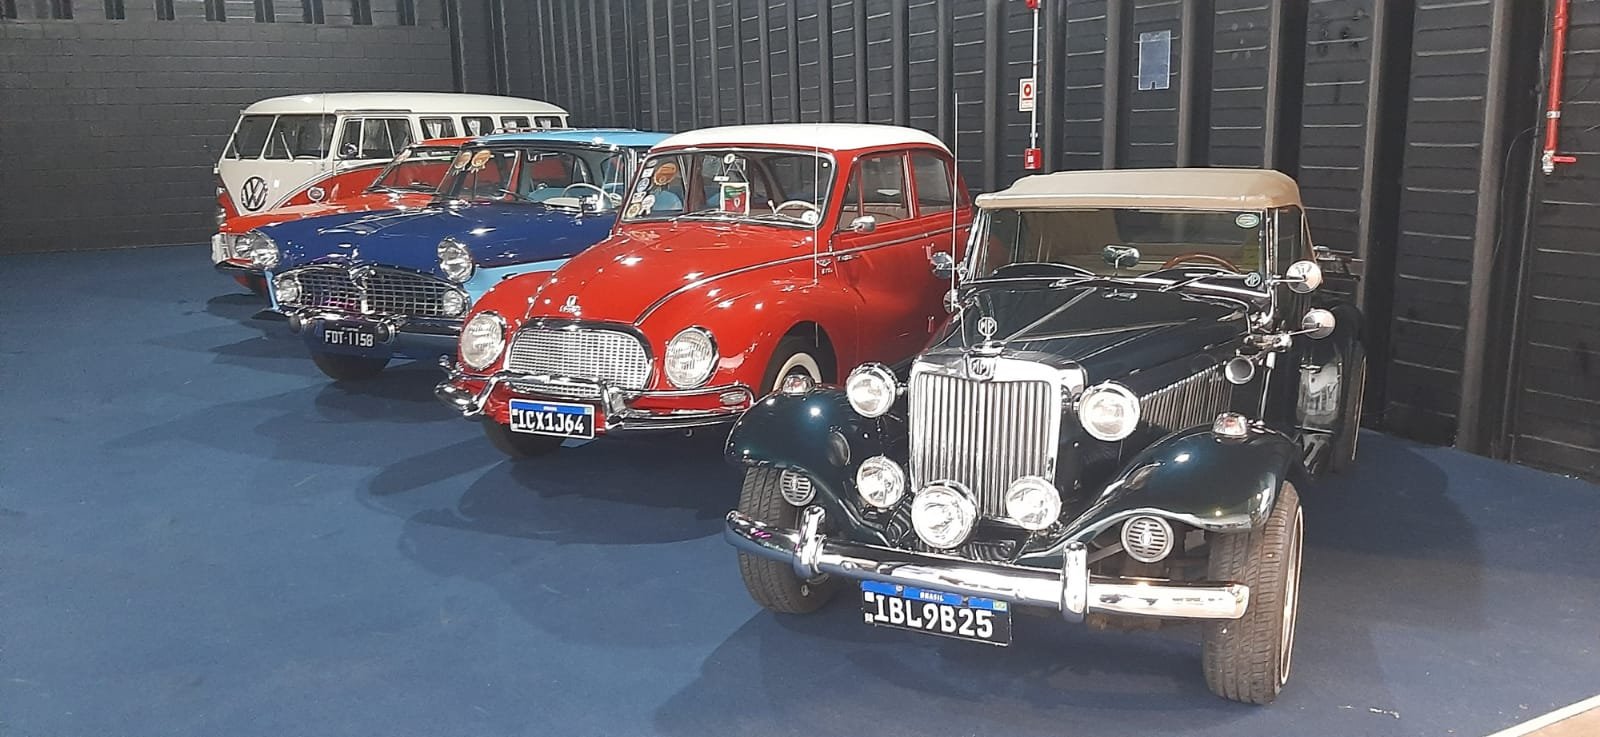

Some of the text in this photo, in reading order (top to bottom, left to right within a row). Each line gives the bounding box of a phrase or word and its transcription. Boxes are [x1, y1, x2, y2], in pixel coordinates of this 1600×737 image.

[518, 409, 585, 433] ICX1J64
[919, 591, 945, 602] BRASIL
[874, 594, 994, 638] IBL9B25
